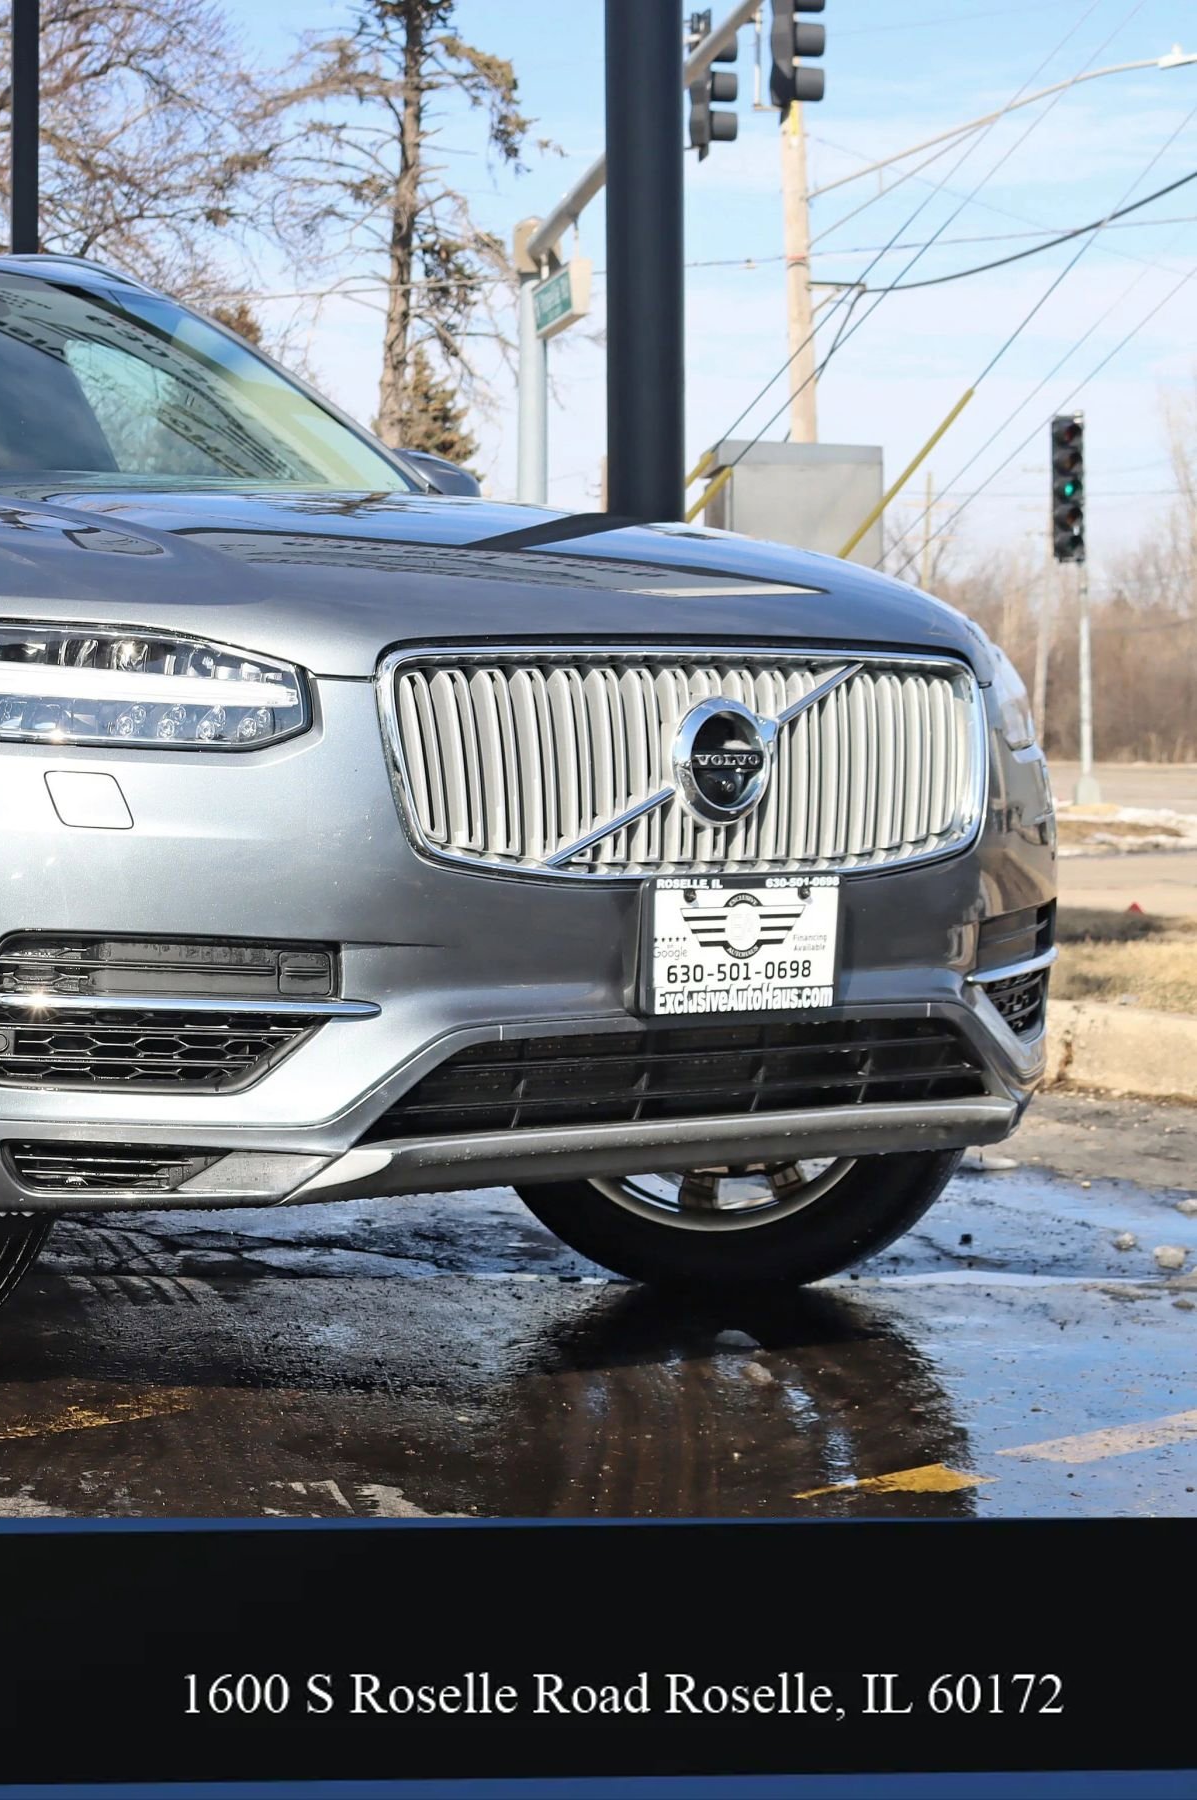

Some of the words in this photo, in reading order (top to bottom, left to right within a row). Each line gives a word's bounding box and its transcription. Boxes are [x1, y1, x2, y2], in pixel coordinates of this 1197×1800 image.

[694, 754, 761, 766] VOLVO
[656, 879, 709, 889] ROSELLE,
[711, 879, 723, 889] IL
[765, 876, 840, 888] 630-501-0698
[793, 933, 827, 943] Financing
[653, 946, 688, 960] Google
[794, 943, 826, 952] Available
[667, 960, 812, 984] 630-501-0698
[654, 983, 834, 1015] ExclusiveAutoHaus.com
